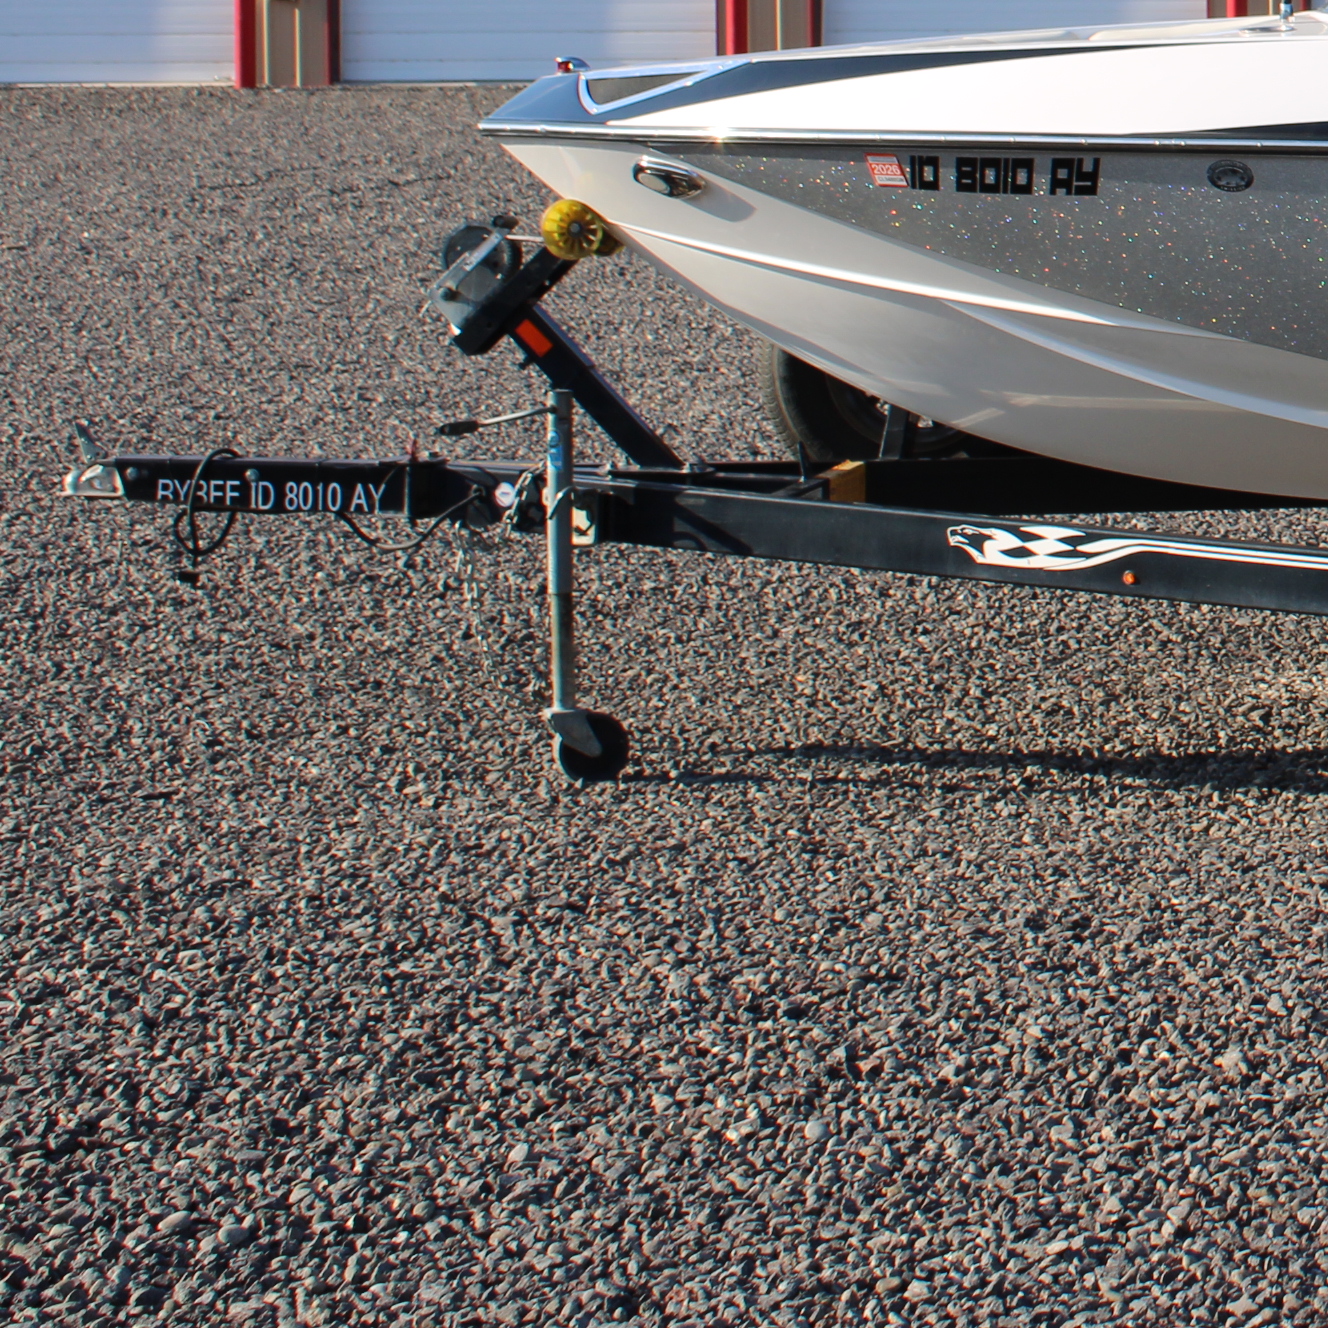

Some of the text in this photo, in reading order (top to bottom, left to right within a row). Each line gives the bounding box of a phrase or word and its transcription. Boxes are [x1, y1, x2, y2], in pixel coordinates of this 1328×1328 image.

[871, 164, 901, 175] 2026
[909, 155, 1100, 196] ID 8010 AY
[250, 480, 275, 510] ID
[284, 480, 342, 511] 8010
[350, 482, 386, 514] AY
